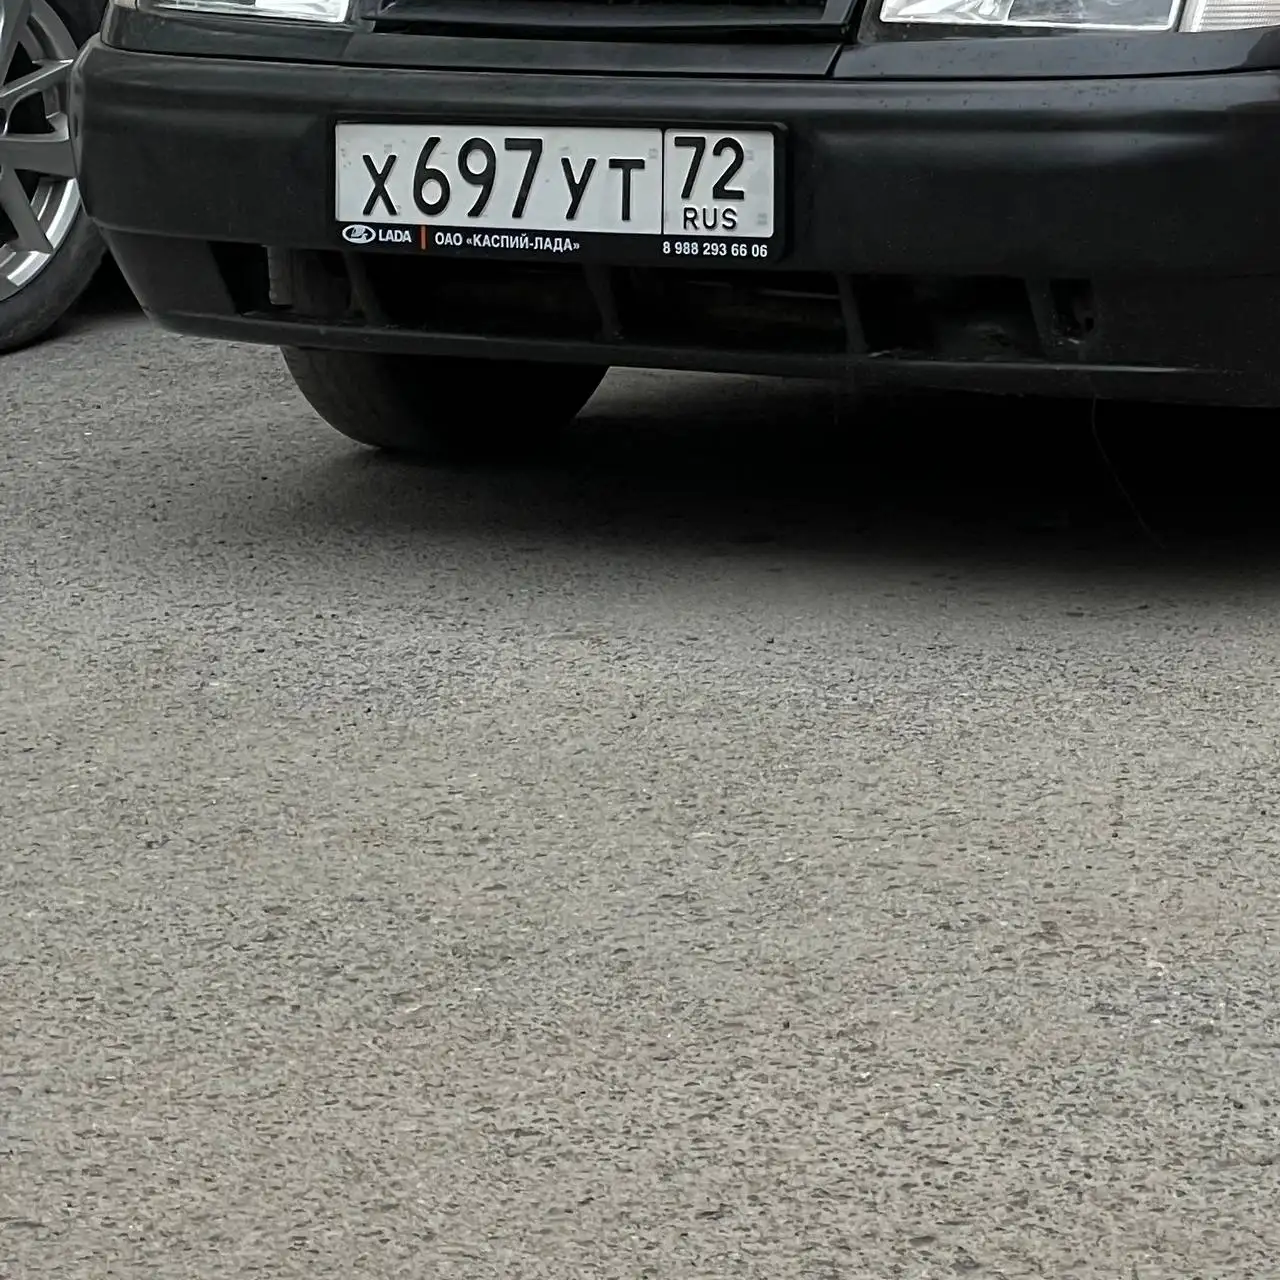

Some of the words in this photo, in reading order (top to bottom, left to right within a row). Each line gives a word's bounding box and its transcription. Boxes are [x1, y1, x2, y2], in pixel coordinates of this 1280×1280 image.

[674, 136, 745, 200] 72
[683, 207, 738, 231] RUS
[378, 228, 412, 244] LADA
[434, 231, 463, 247] ОАО
[662, 241, 671, 254] 8
[674, 241, 699, 255] 988
[702, 242, 727, 256] 293
[731, 243, 748, 257] 66
[751, 244, 768, 258] 06
